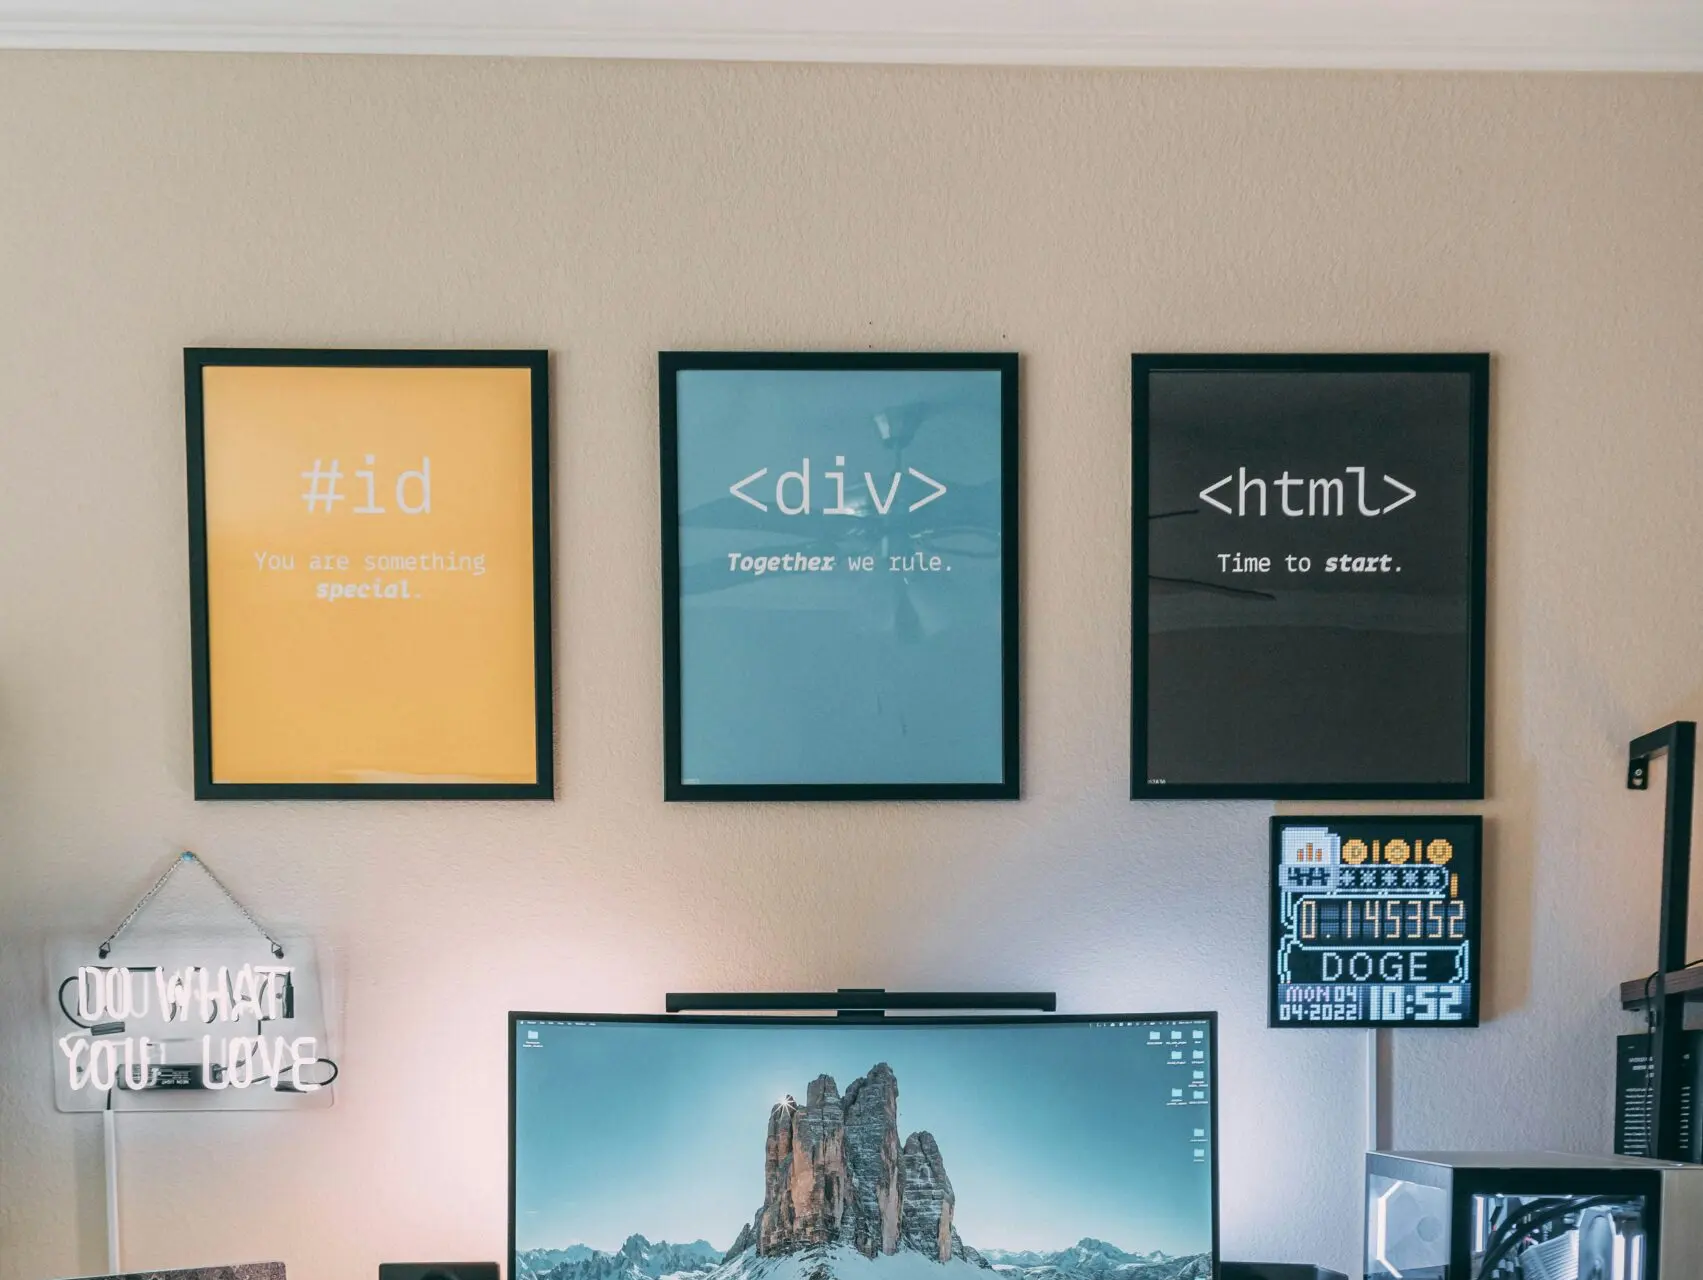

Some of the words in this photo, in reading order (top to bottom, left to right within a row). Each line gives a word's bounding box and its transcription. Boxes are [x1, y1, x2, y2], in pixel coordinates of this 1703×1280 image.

[300, 455, 432, 515] #id
[728, 454, 947, 516] <div>
[1198, 466, 1417, 517] <html>
[254, 550, 295, 572] You
[309, 554, 349, 572] are
[364, 550, 486, 575] something
[727, 552, 835, 576] Together
[848, 556, 874, 571] we
[889, 551, 951, 572] rule.
[1216, 551, 1271, 574] Time
[1284, 554, 1312, 574] to
[1324, 553, 1403, 574] start.
[315, 577, 422, 601] special.
[1301, 900, 1466, 939] 0.145352
[1322, 952, 1428, 981] DOGE
[78, 965, 129, 1022] DO
[154, 963, 295, 1022] WHAT
[1286, 985, 1330, 1002] MON
[1334, 986, 1357, 1002] 04
[1369, 985, 1463, 1020] 10:52
[59, 1035, 150, 1091] YOU
[202, 1034, 322, 1091] LOVE
